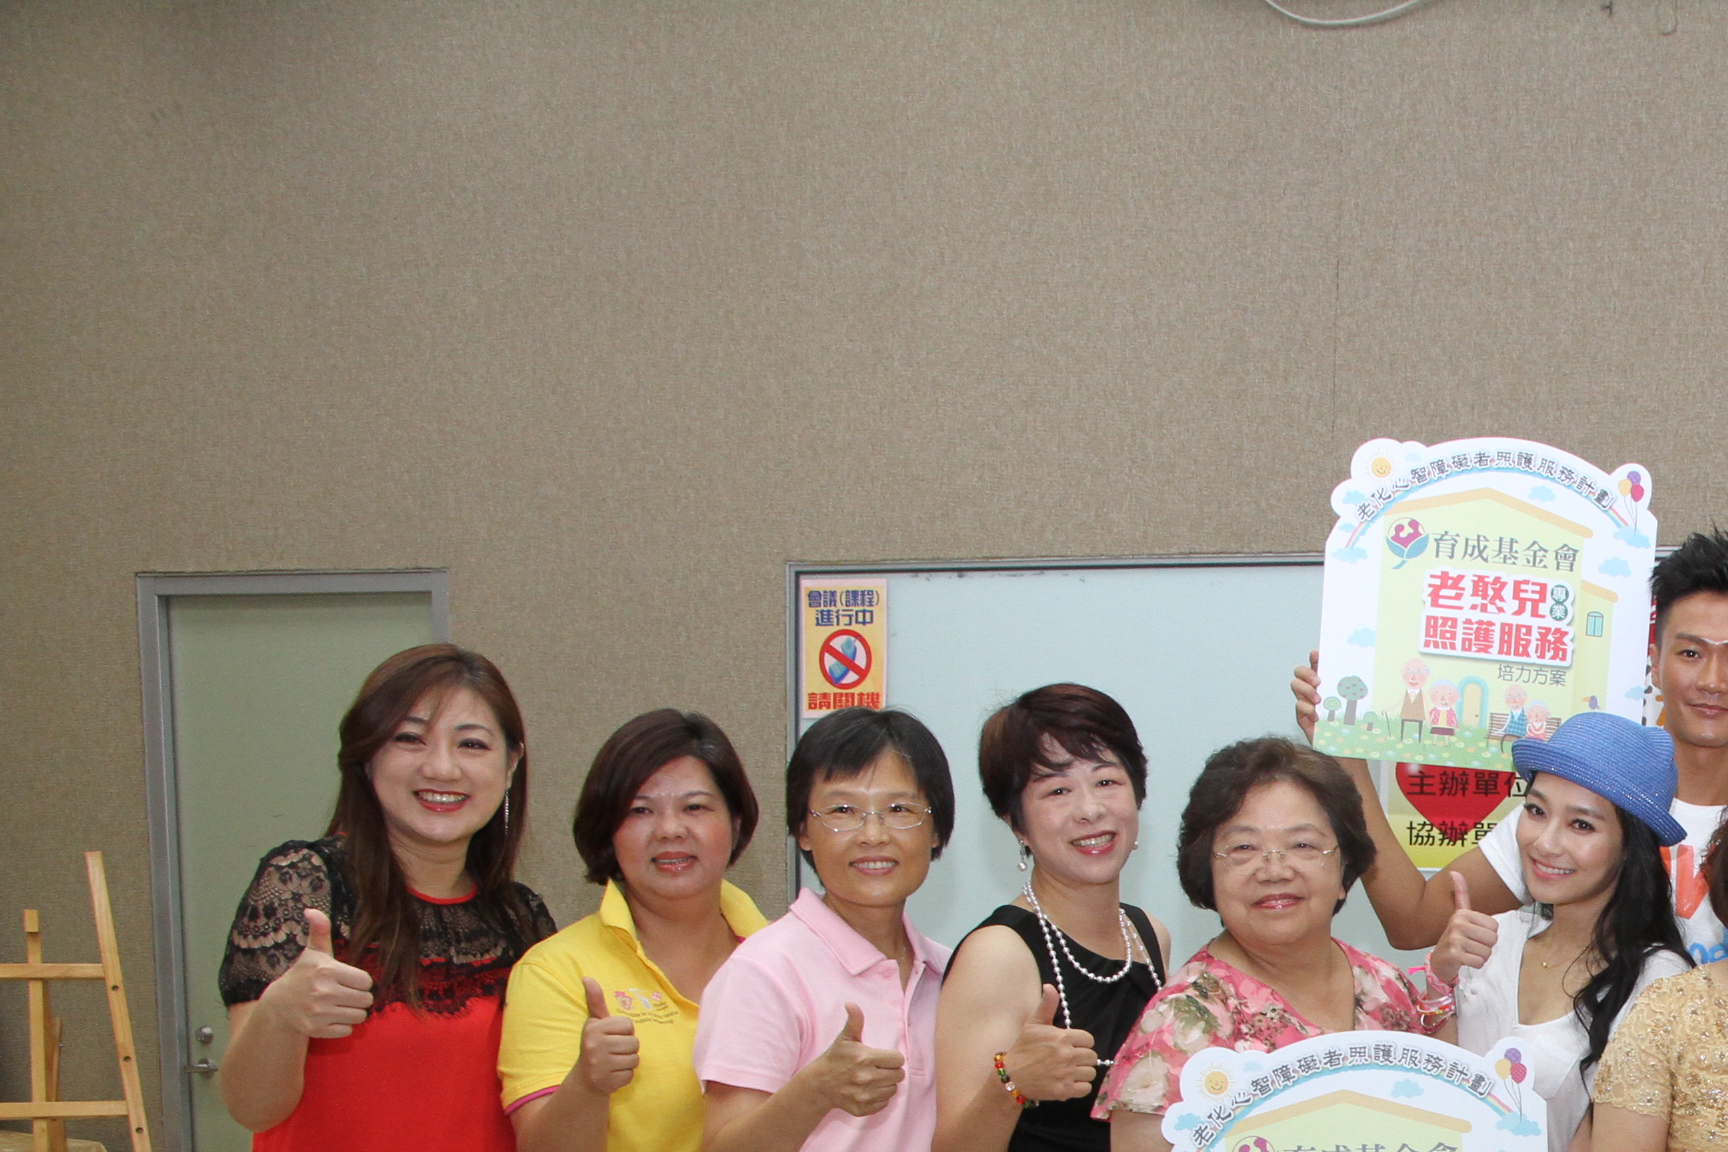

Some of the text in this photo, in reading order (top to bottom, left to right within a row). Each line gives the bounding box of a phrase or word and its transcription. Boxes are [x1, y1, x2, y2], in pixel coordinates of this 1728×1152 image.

[1356, 450, 1618, 522] 老化心智障礙者照護服務計劃
[1432, 530, 1580, 573] 育成基金會
[815, 609, 874, 626] 進行中
[1427, 571, 1548, 620] 老憨兒
[1550, 586, 1569, 620] 專業
[1423, 614, 1571, 662] 照護服務
[1497, 664, 1567, 687] 培力方案
[1191, 1042, 1496, 1149] 老化心智障礙者照護服務計劃
